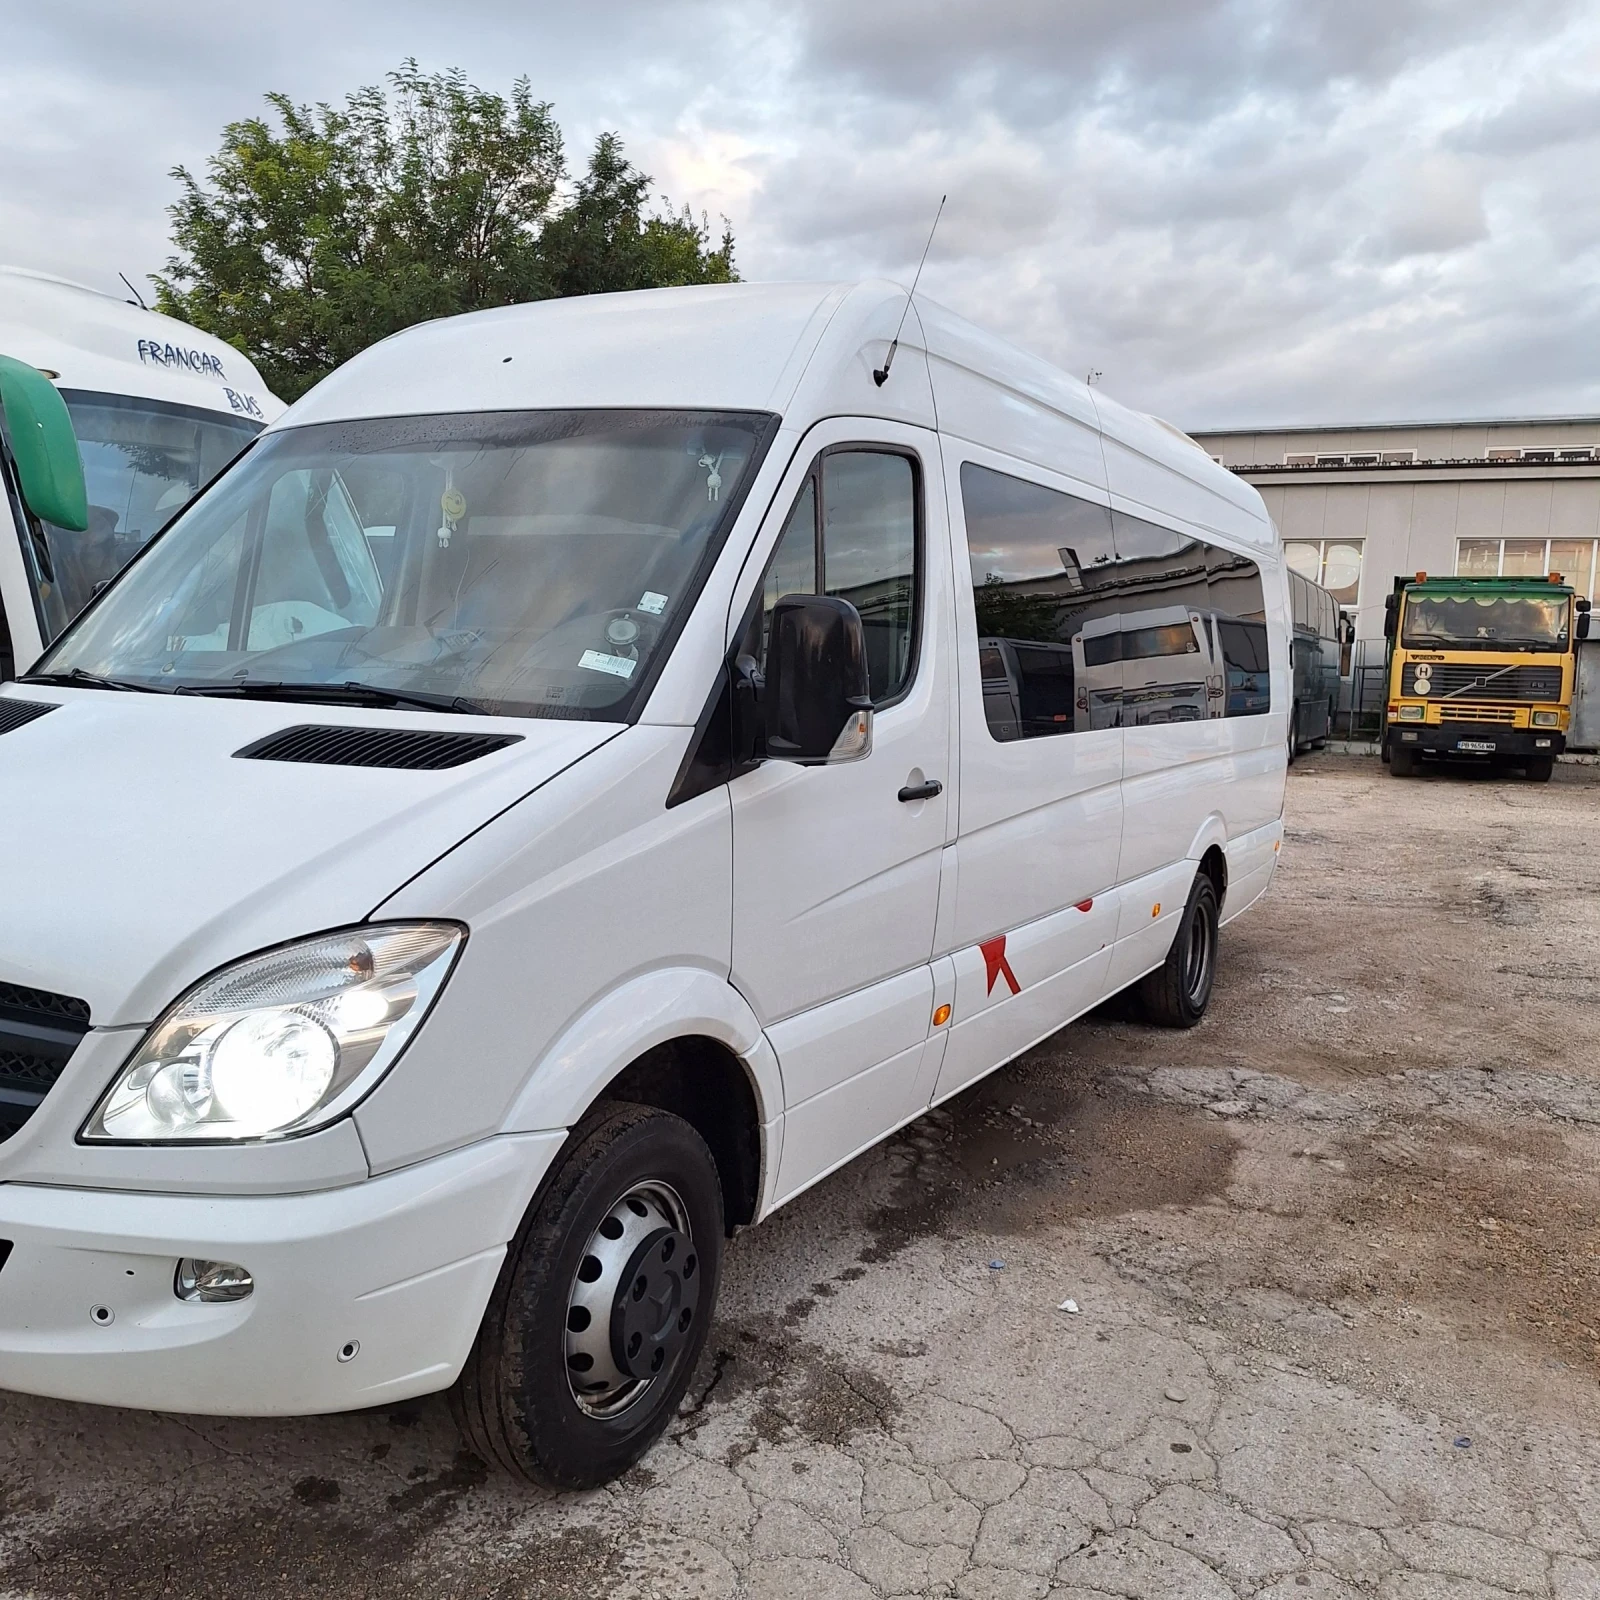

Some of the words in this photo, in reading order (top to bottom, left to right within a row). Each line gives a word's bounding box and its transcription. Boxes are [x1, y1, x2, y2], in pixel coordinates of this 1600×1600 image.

[138, 339, 228, 381] FRANCAR
[222, 387, 264, 419] BUS
[1419, 667, 1428, 676] H
